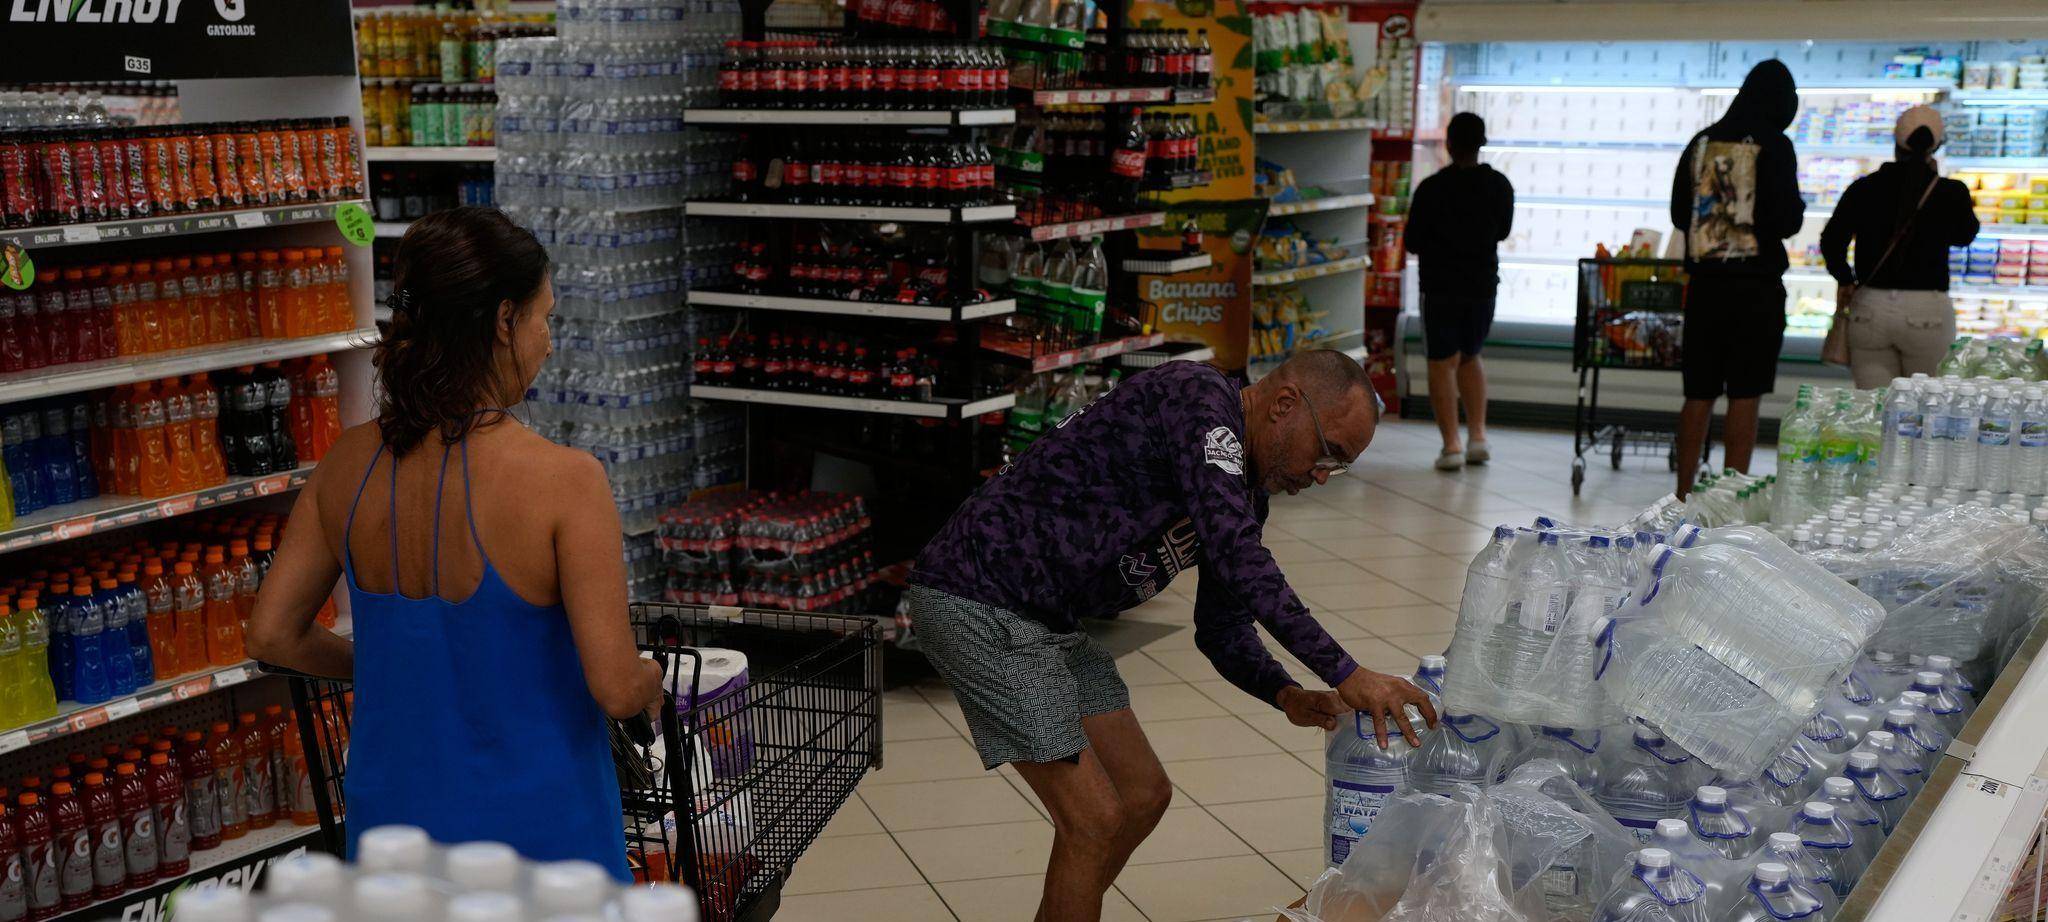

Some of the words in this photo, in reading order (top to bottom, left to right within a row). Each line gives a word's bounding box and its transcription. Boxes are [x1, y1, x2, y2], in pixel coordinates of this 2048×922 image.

[207, 25, 256, 36] GATORADE
[127, 58, 149, 71] G35
[99, 227, 119, 238] NERGY
[142, 224, 166, 234] ENERGY
[34, 233, 60, 244] ENERGY
[1149, 280, 1237, 300] Banana
[1162, 301, 1224, 326] Chips
[259, 482, 268, 495] G
[163, 503, 174, 517] G
[178, 686, 189, 698] G
[75, 716, 86, 729] G
[135, 816, 152, 838] G
[102, 826, 119, 849] G
